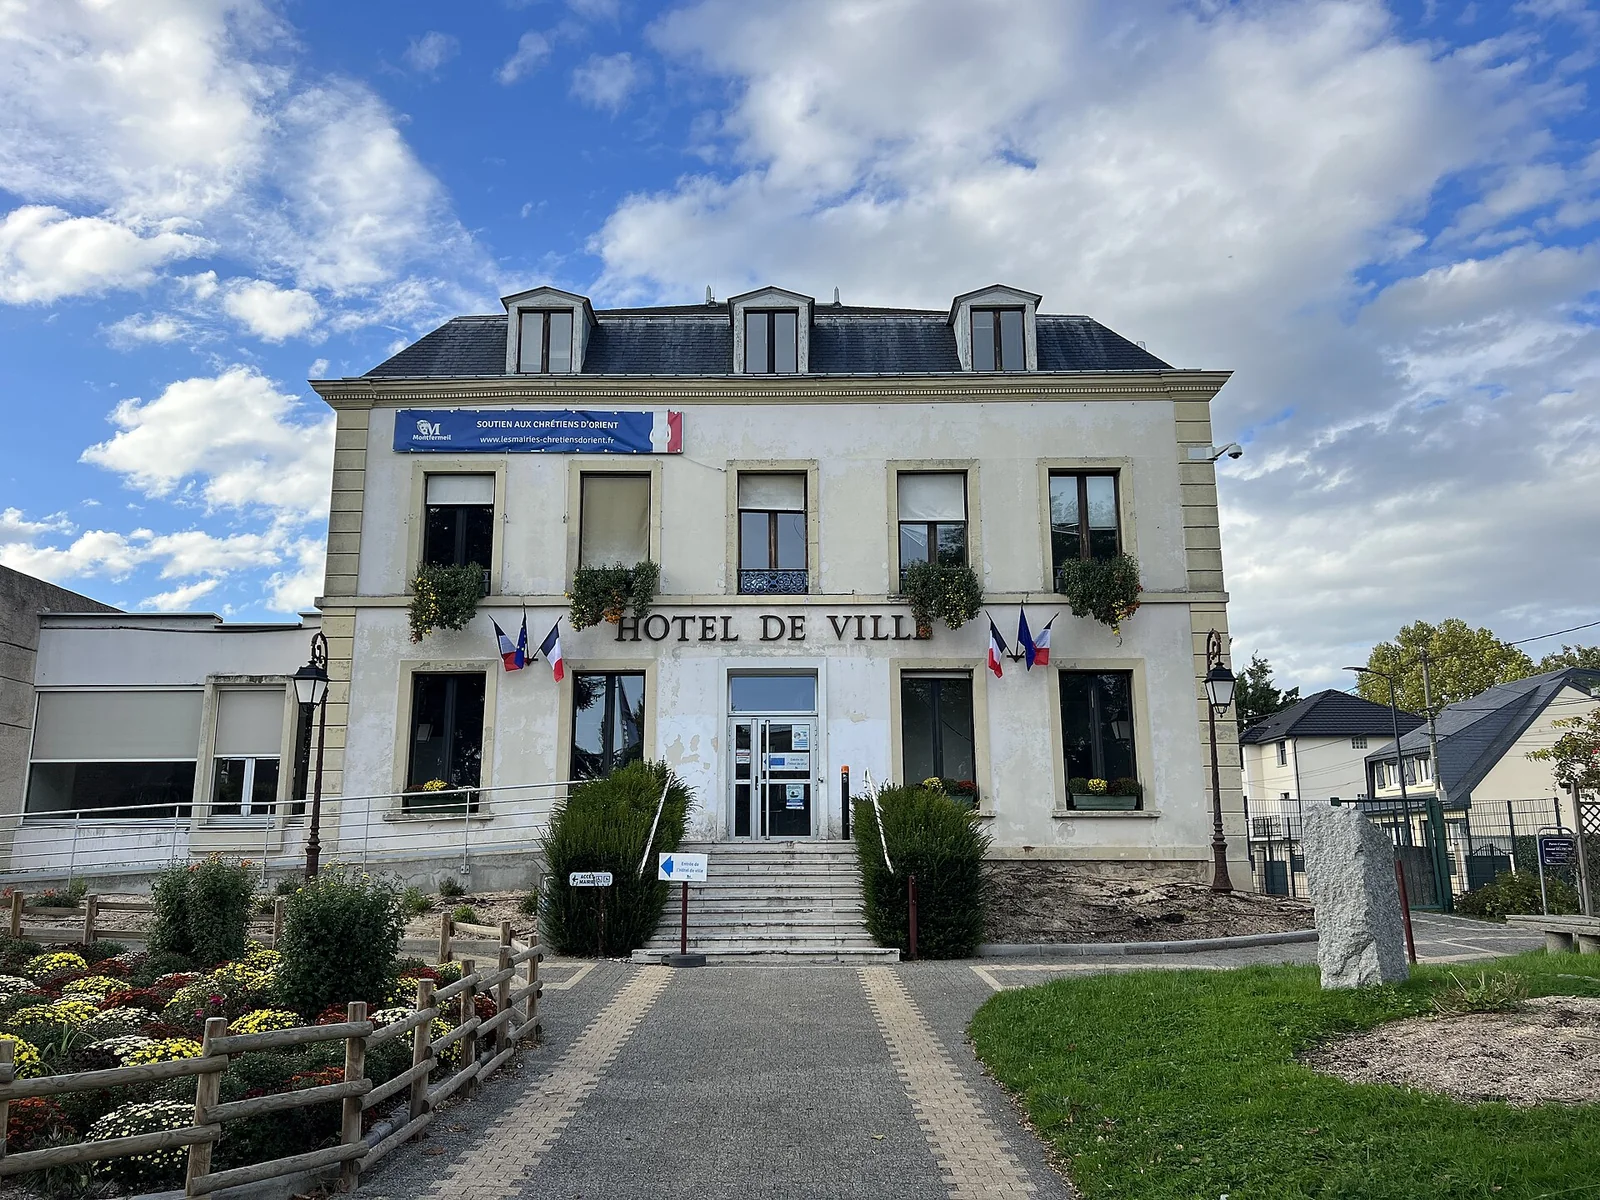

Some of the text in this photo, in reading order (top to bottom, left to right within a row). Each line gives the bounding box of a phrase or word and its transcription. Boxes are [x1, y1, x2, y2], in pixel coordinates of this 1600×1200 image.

[476, 419, 619, 429] SOUTIEN AUX CHRÉTIENS D'ORIENT
[480, 435, 615, 444] www.lesmairies-chretiensdorient.fr
[614, 614, 739, 642] HOTEL
[759, 615, 806, 642] DE
